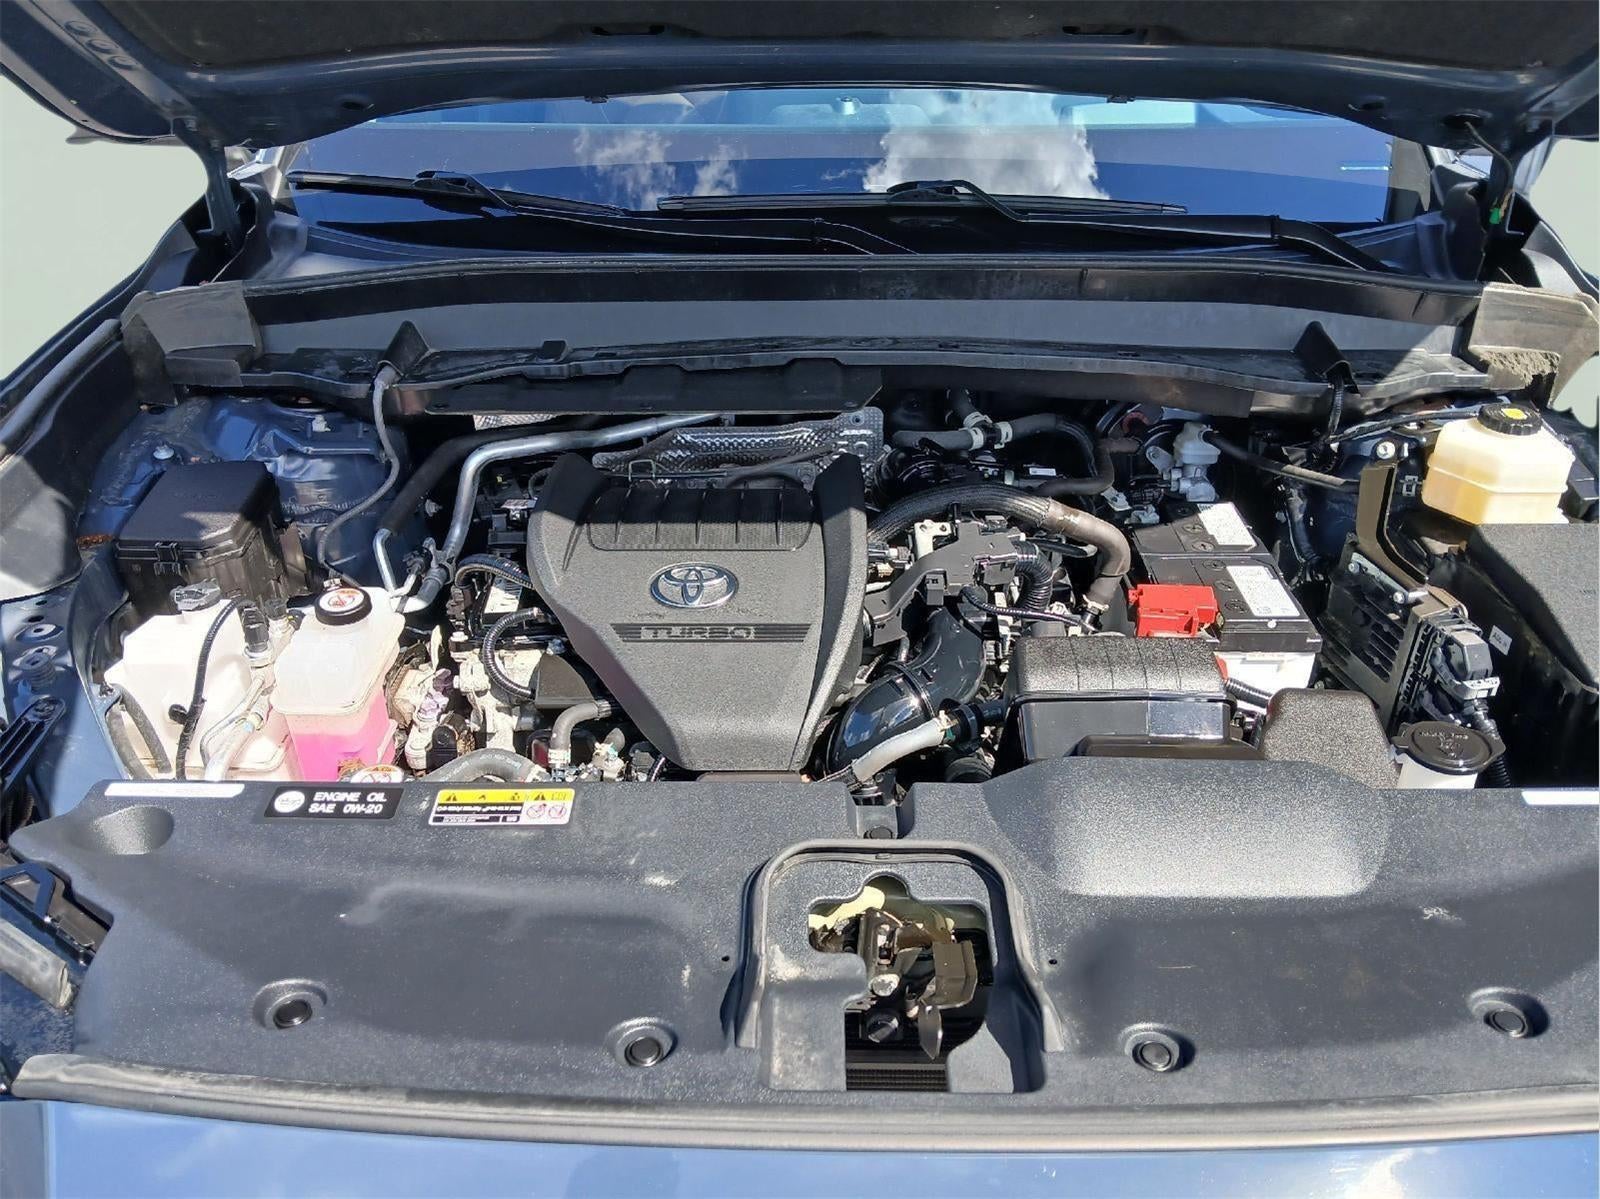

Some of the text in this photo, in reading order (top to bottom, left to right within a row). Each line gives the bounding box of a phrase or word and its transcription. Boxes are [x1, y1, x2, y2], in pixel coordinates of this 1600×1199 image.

[644, 627, 753, 639] TURBO
[313, 791, 387, 802] ENGINE OIL
[308, 803, 384, 814] SAE 0W-20
